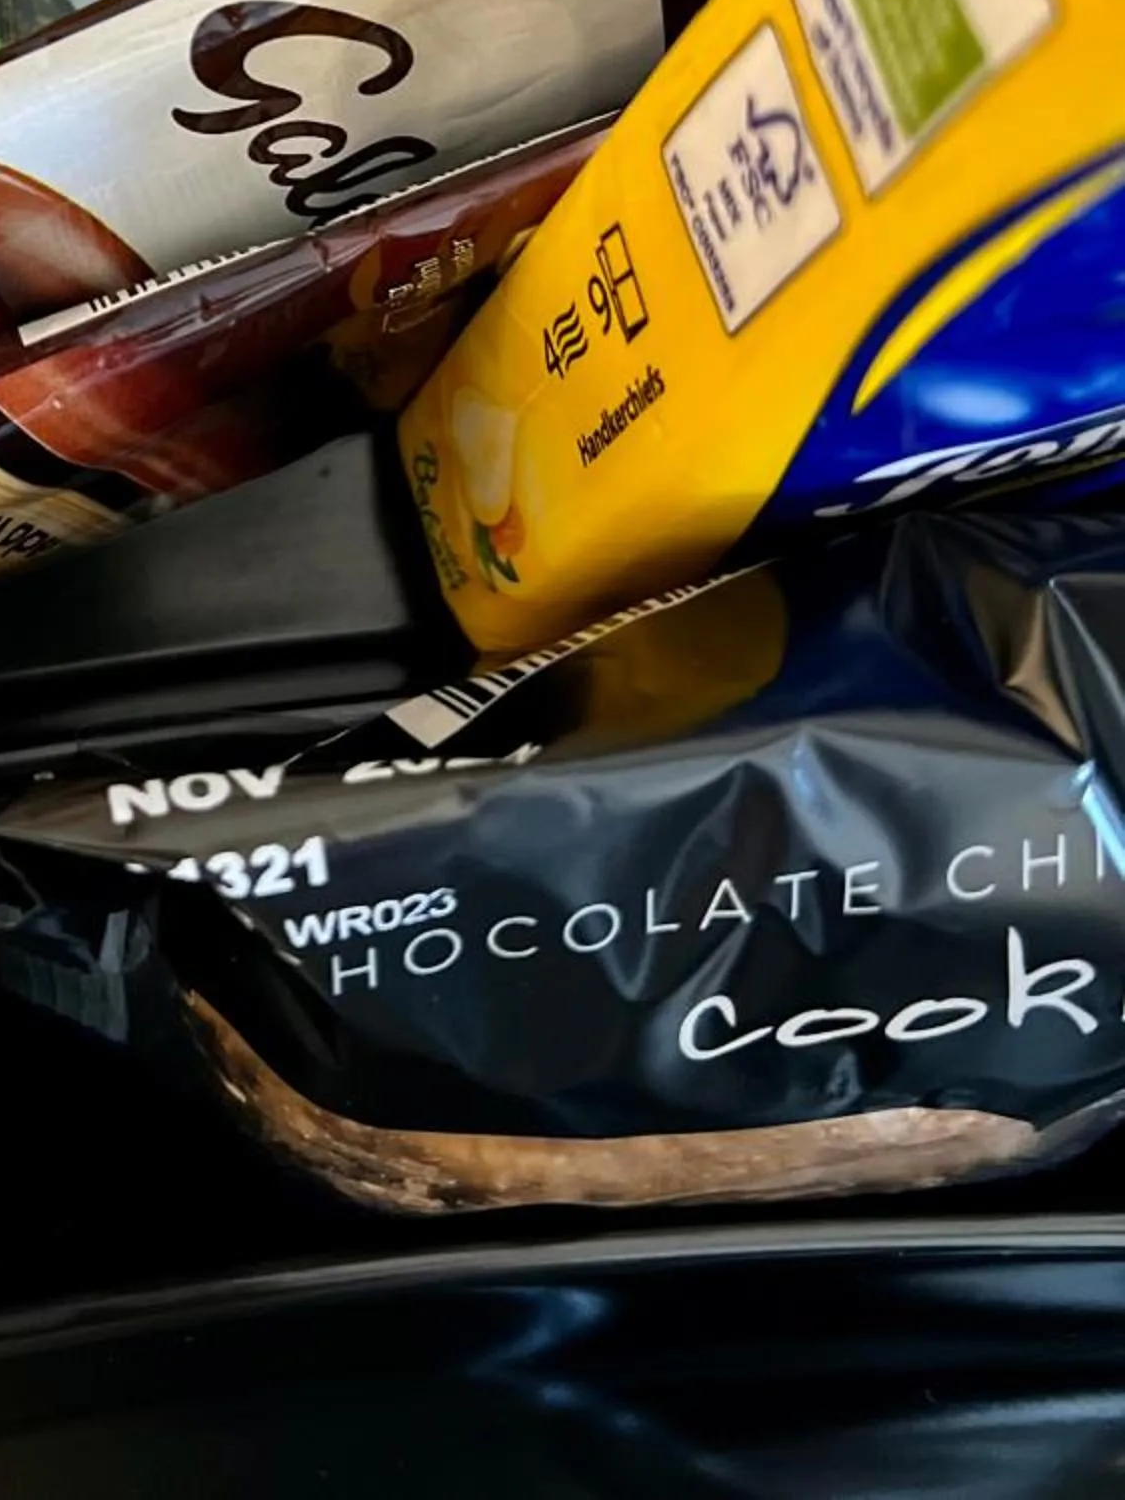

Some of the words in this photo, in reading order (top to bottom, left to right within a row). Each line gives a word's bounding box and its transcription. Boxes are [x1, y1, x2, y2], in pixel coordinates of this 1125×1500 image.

[586, 275, 614, 336] 9
[542, 327, 567, 381] 4
[575, 362, 668, 469] Handkerchiefs
[106, 763, 289, 826] NOV
[284, 886, 460, 949] WR023
[330, 861, 884, 996] HOCOLATE
[946, 833, 1109, 900] CHI
[678, 925, 1125, 1061] cook
